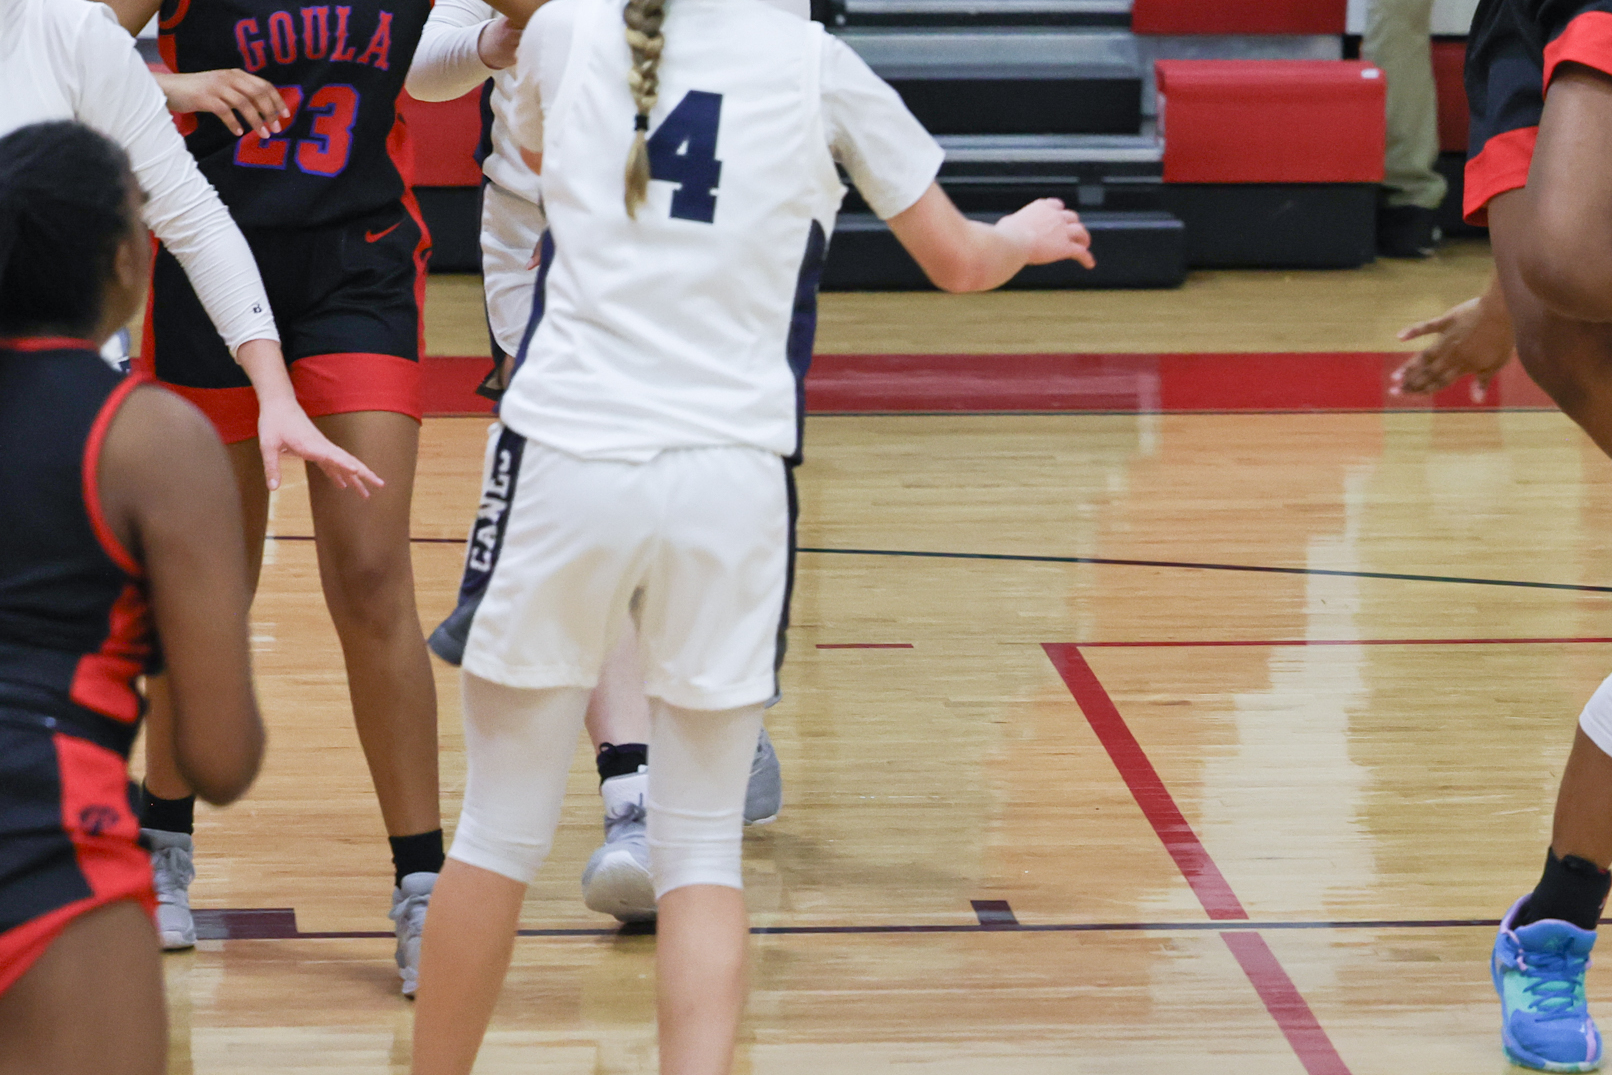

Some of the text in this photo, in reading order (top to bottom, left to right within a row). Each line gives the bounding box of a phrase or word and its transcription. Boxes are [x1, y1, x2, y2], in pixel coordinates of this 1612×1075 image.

[233, 4, 394, 72] GOULA
[232, 82, 362, 178] 23
[646, 89, 724, 224] 4
